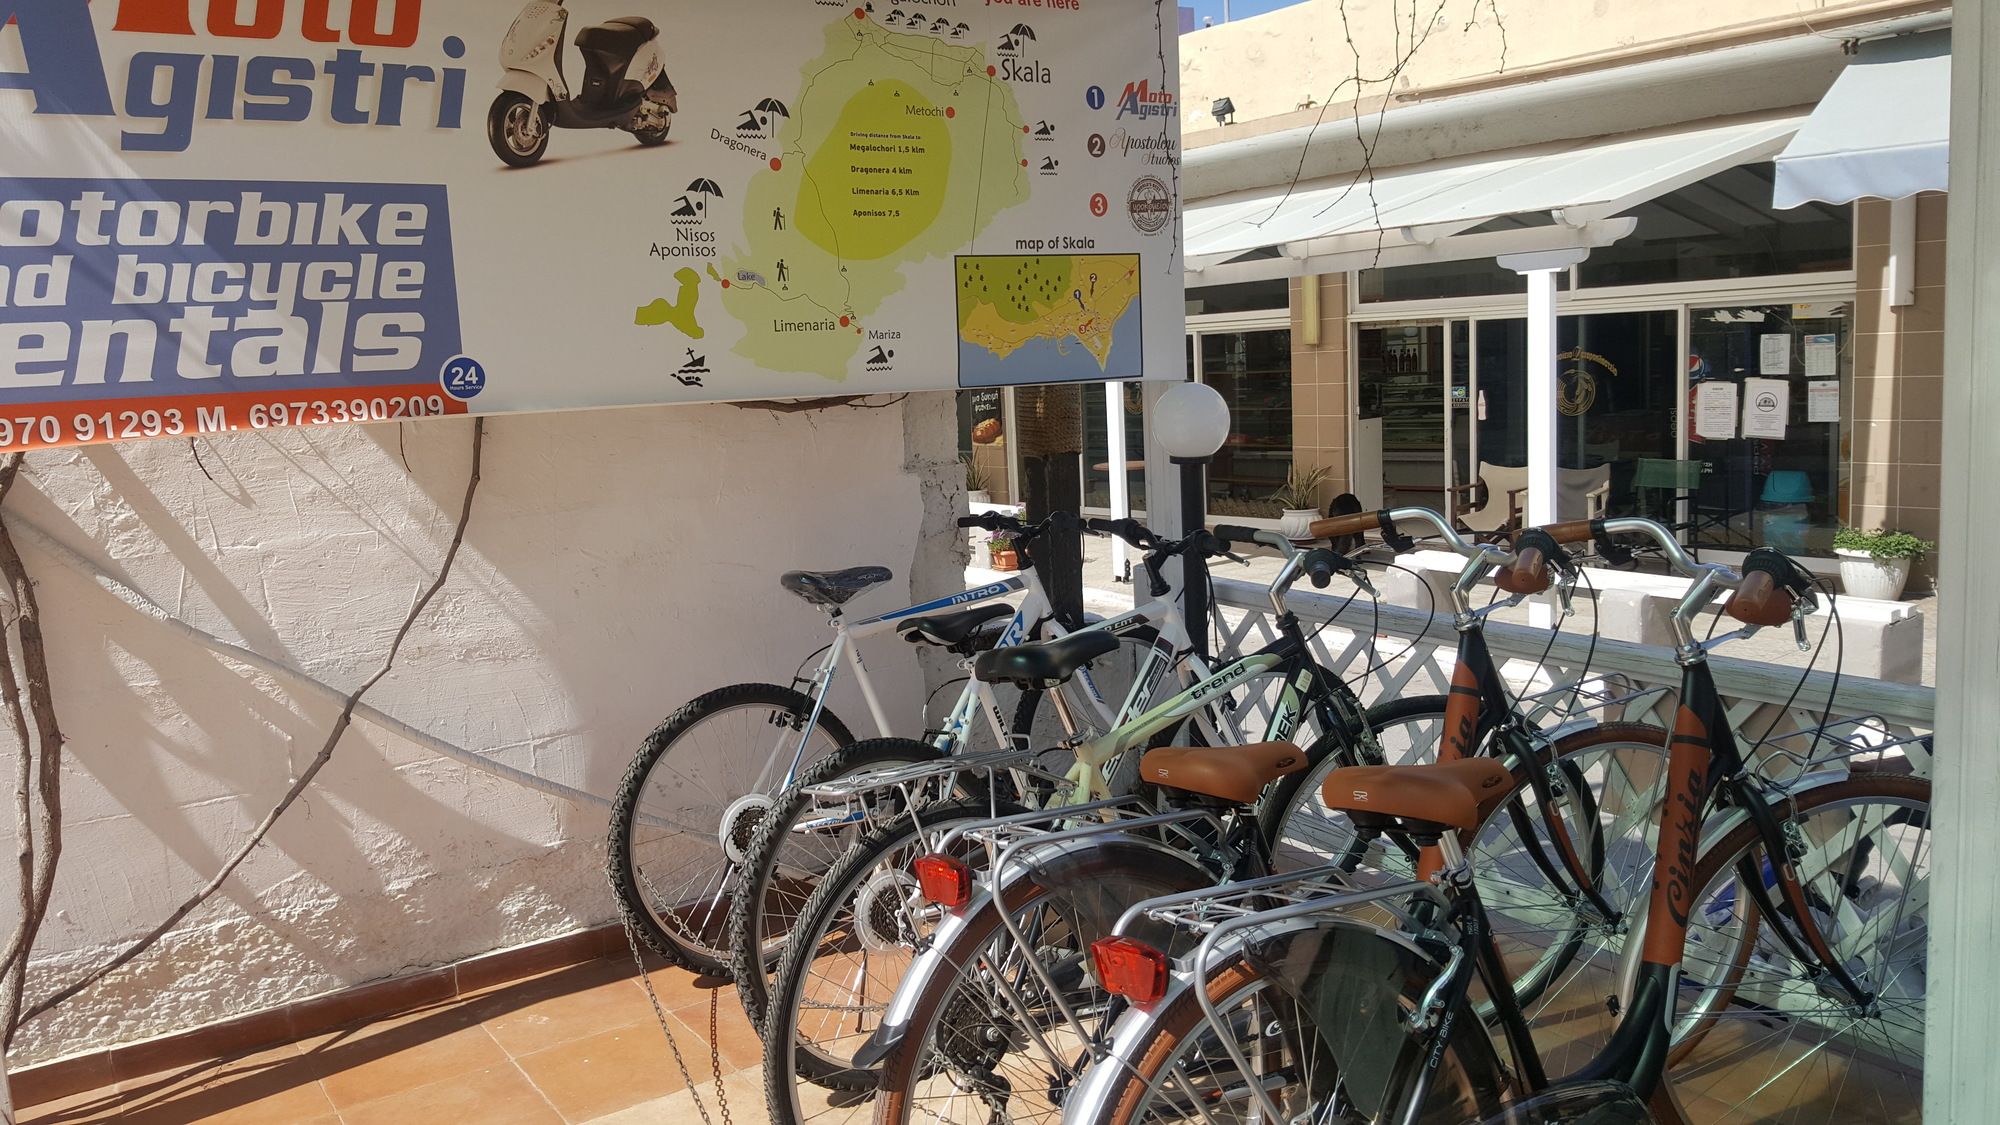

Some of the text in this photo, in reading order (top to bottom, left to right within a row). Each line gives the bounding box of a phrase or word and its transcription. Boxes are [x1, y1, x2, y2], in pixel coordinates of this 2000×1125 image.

[1001, 58, 1051, 84] Skala
[1116, 79, 1173, 107] Moto
[905, 105, 944, 117] Metochi
[1115, 92, 1178, 120] Agistri
[710, 128, 767, 161] Dragonera
[849, 144, 896, 153] Megalochori
[898, 146, 910, 154] 1,5
[850, 166, 890, 175] Dragonera
[851, 187, 920, 196] Limenaria 6,5 Klm
[852, 209, 900, 218] Aponisos 7,5
[676, 228, 715, 242] Nisos
[1015, 236, 1095, 252] map of Skala
[649, 243, 717, 261] Aponisos
[112, 252, 426, 309] bicycle
[737, 272, 756, 281] Lake
[773, 318, 836, 333] Limenaria
[868, 329, 901, 340] Mariza
[451, 366, 479, 385] 24
[73, 407, 185, 442] 91293
[196, 405, 238, 433] M.
[249, 394, 445, 430] 6973390209
[951, 584, 1001, 605] INTRO
[1190, 662, 1248, 700] trend
[1667, 768, 1702, 929] Cinzia
[1430, 1009, 1454, 1070] CITY BIKE
